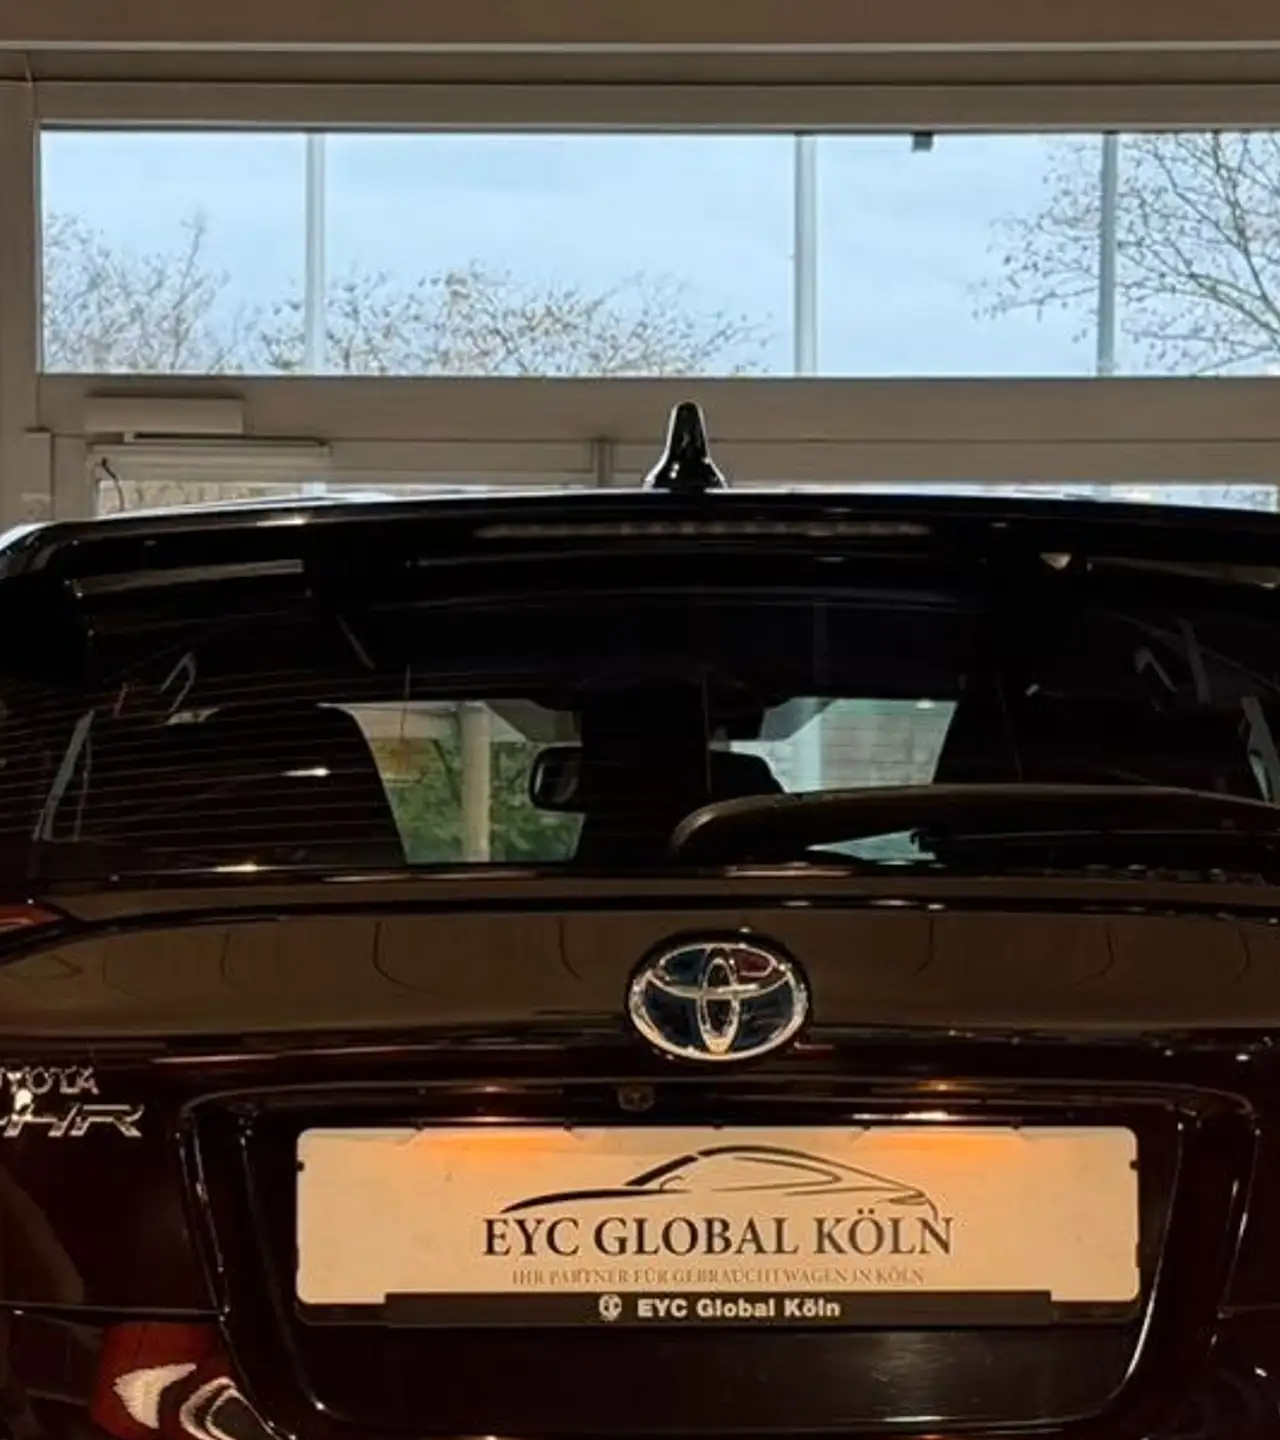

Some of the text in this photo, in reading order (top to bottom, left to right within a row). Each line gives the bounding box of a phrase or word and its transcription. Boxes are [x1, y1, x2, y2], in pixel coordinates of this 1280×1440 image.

[483, 1207, 955, 1257] EYC GLOBAL KÖLN
[512, 1269, 545, 1285] IHR
[549, 1268, 629, 1285] PARTNER
[633, 1266, 669, 1285] FÜR
[850, 1267, 872, 1284] IN
[875, 1264, 925, 1284] KÖLN
[637, 1298, 688, 1317] EYC
[696, 1296, 776, 1317] Global
[783, 1297, 841, 1317] Köln
